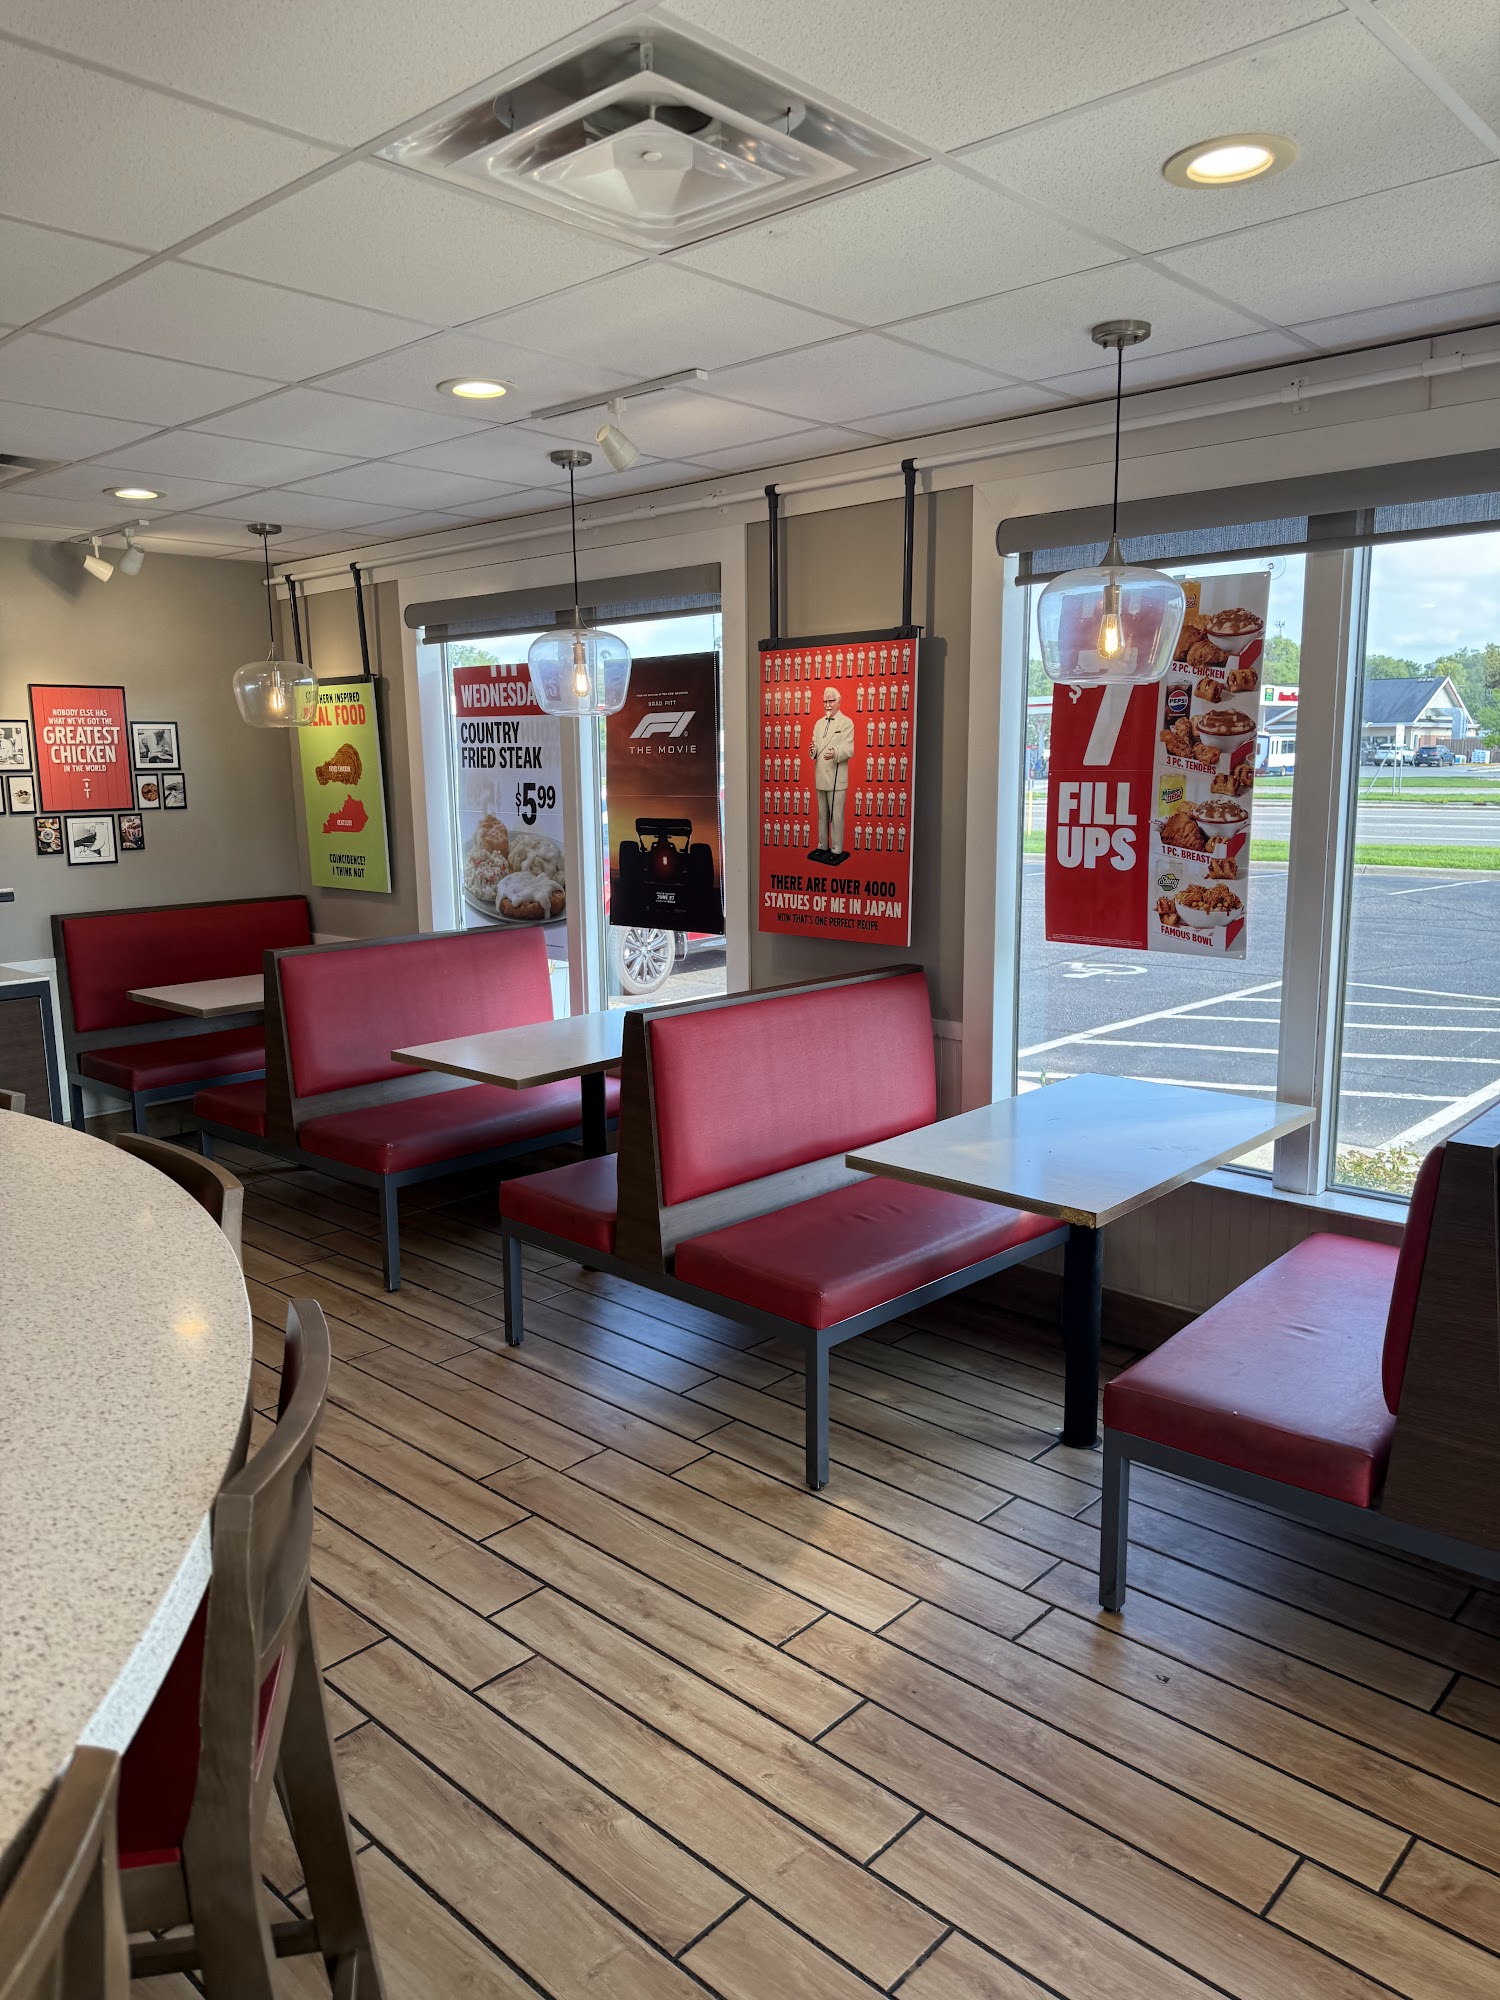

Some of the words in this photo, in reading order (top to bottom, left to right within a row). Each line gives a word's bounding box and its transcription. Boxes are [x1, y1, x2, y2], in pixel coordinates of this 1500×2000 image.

[1172, 662, 1177, 671] 2
[1178, 664, 1191, 674] PC.
[1192, 666, 1225, 679] CHICKEN
[334, 691, 360, 703] INSPIRED
[48, 717, 65, 725] WHAT
[67, 717, 86, 725] WE'VE
[87, 717, 100, 725] GOT
[101, 717, 113, 725] THE
[52, 708, 78, 716] NOBODY
[80, 709, 94, 717] ELSE
[95, 709, 108, 717] HAS
[334, 704, 366, 726] FOOD
[460, 721, 520, 744] COUNTRY
[629, 710, 697, 739] F1
[43, 726, 120, 745] GREATEST
[51, 745, 117, 764] CHICKEN
[461, 746, 496, 769] FRIED
[499, 746, 542, 769] STEAK
[629, 746, 652, 754] THE
[658, 744, 697, 754] MOVIE
[85, 764, 107, 772] WORLD
[1166, 756, 1171, 765] 3
[1172, 758, 1184, 768] PC.
[1185, 760, 1217, 775] TENDERS
[1057, 781, 1138, 826] FILL
[1056, 825, 1137, 871] UPS
[1162, 845, 1166, 854] 1
[1167, 846, 1180, 857] PC.
[1181, 850, 1211, 864] BREAST
[329, 853, 366, 866] COINCIDENCE?
[332, 866, 335, 875] I
[336, 866, 353, 877] THINK
[353, 867, 365, 878] NOT
[770, 874, 803, 891] THERE
[805, 876, 827, 893] ARE
[830, 878, 860, 895] OVER
[864, 880, 896, 898] 4000
[764, 892, 810, 911] STATUES
[813, 895, 828, 912] OF
[830, 897, 846, 914] ME
[849, 898, 861, 915] IN
[864, 900, 902, 919] JAPAN
[777, 912, 792, 922] NOW
[792, 913, 814, 925] THAT'S
[815, 915, 828, 926] ONE
[829, 917, 855, 929] PERFECT
[857, 918, 879, 931] RECIPE
[1160, 925, 1191, 940] FAMOUS
[1192, 933, 1213, 946] BOWL
